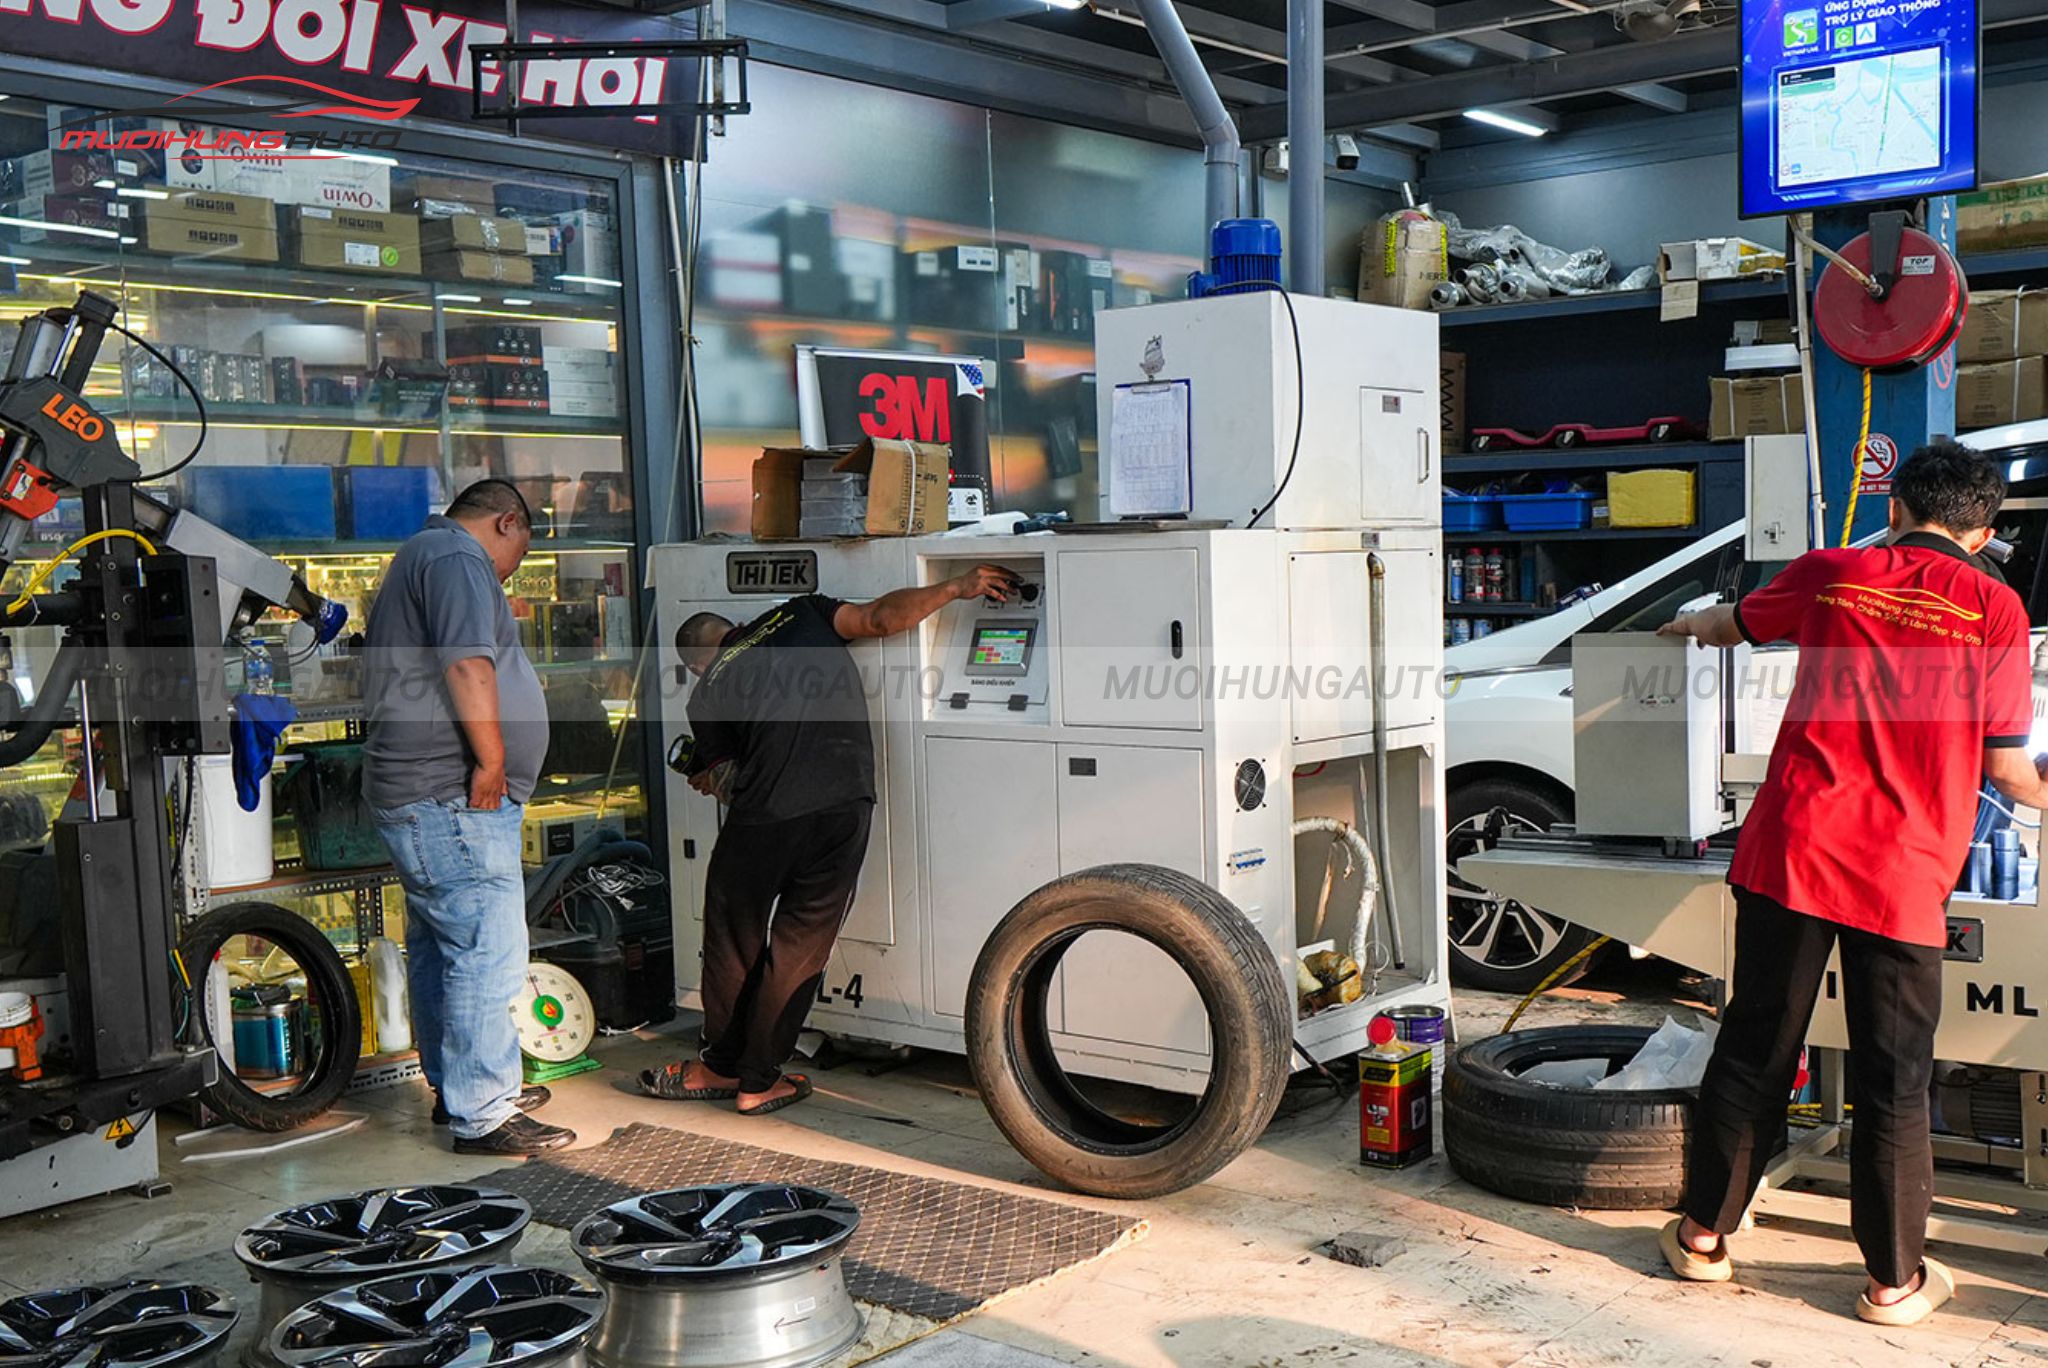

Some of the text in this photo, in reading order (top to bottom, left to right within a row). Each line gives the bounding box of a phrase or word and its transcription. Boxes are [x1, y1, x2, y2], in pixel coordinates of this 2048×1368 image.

[1866, 5, 1896, 17] GIAO
[386, 4, 507, 96] XE
[323, 188, 373, 208] Owin
[41, 392, 105, 442] LEO
[858, 372, 952, 442] 3M
